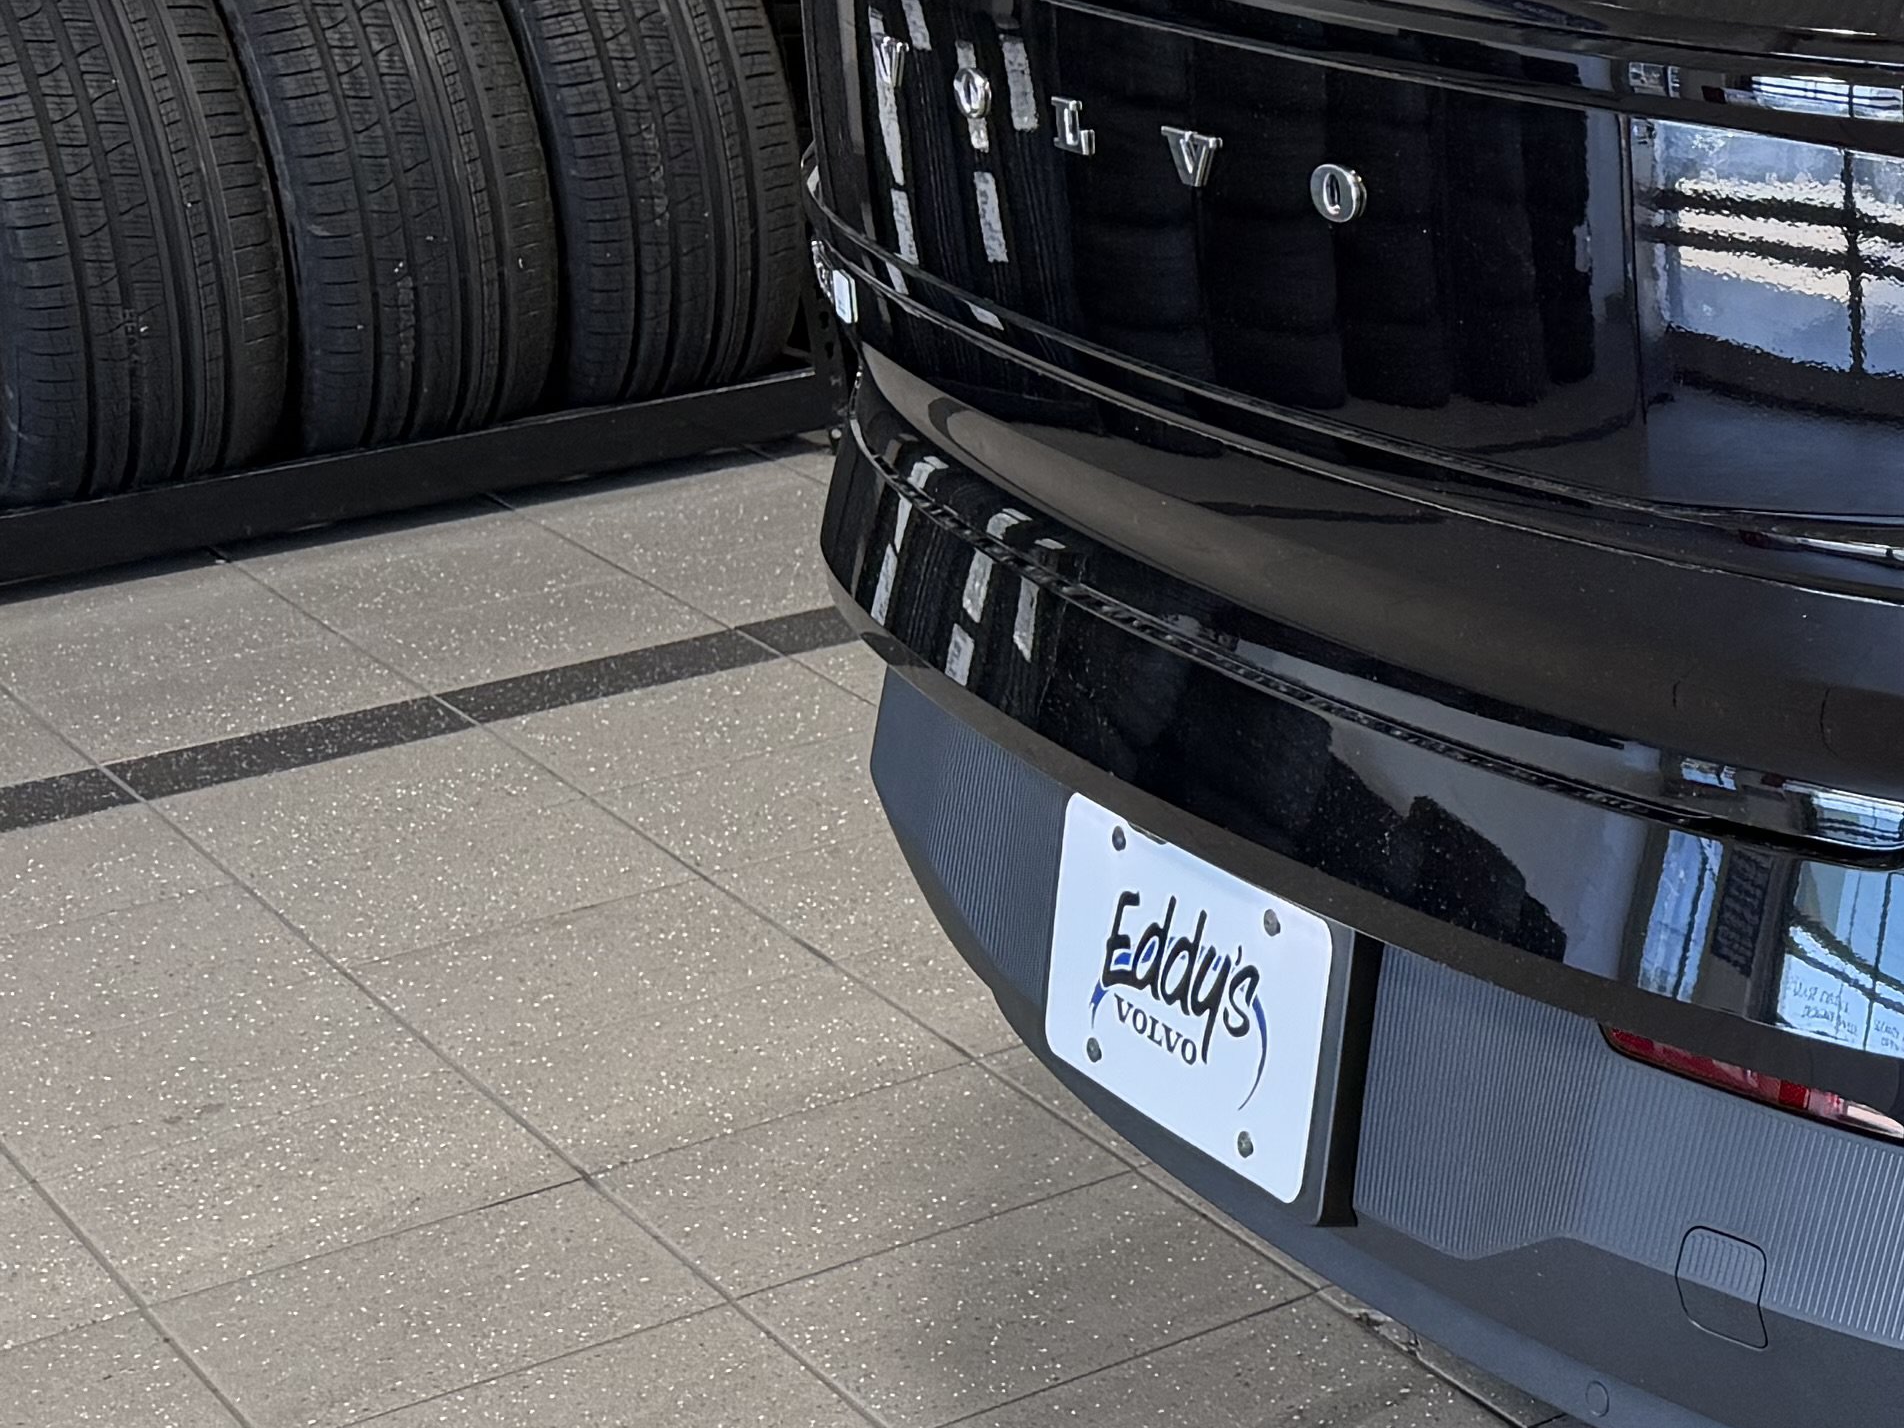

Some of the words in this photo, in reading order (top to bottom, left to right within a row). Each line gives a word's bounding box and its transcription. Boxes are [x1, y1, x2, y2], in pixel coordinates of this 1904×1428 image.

[871, 32, 1368, 224] VOLVO
[1101, 890, 1261, 1065] Eddy's
[1113, 993, 1198, 1066] VOLVO
